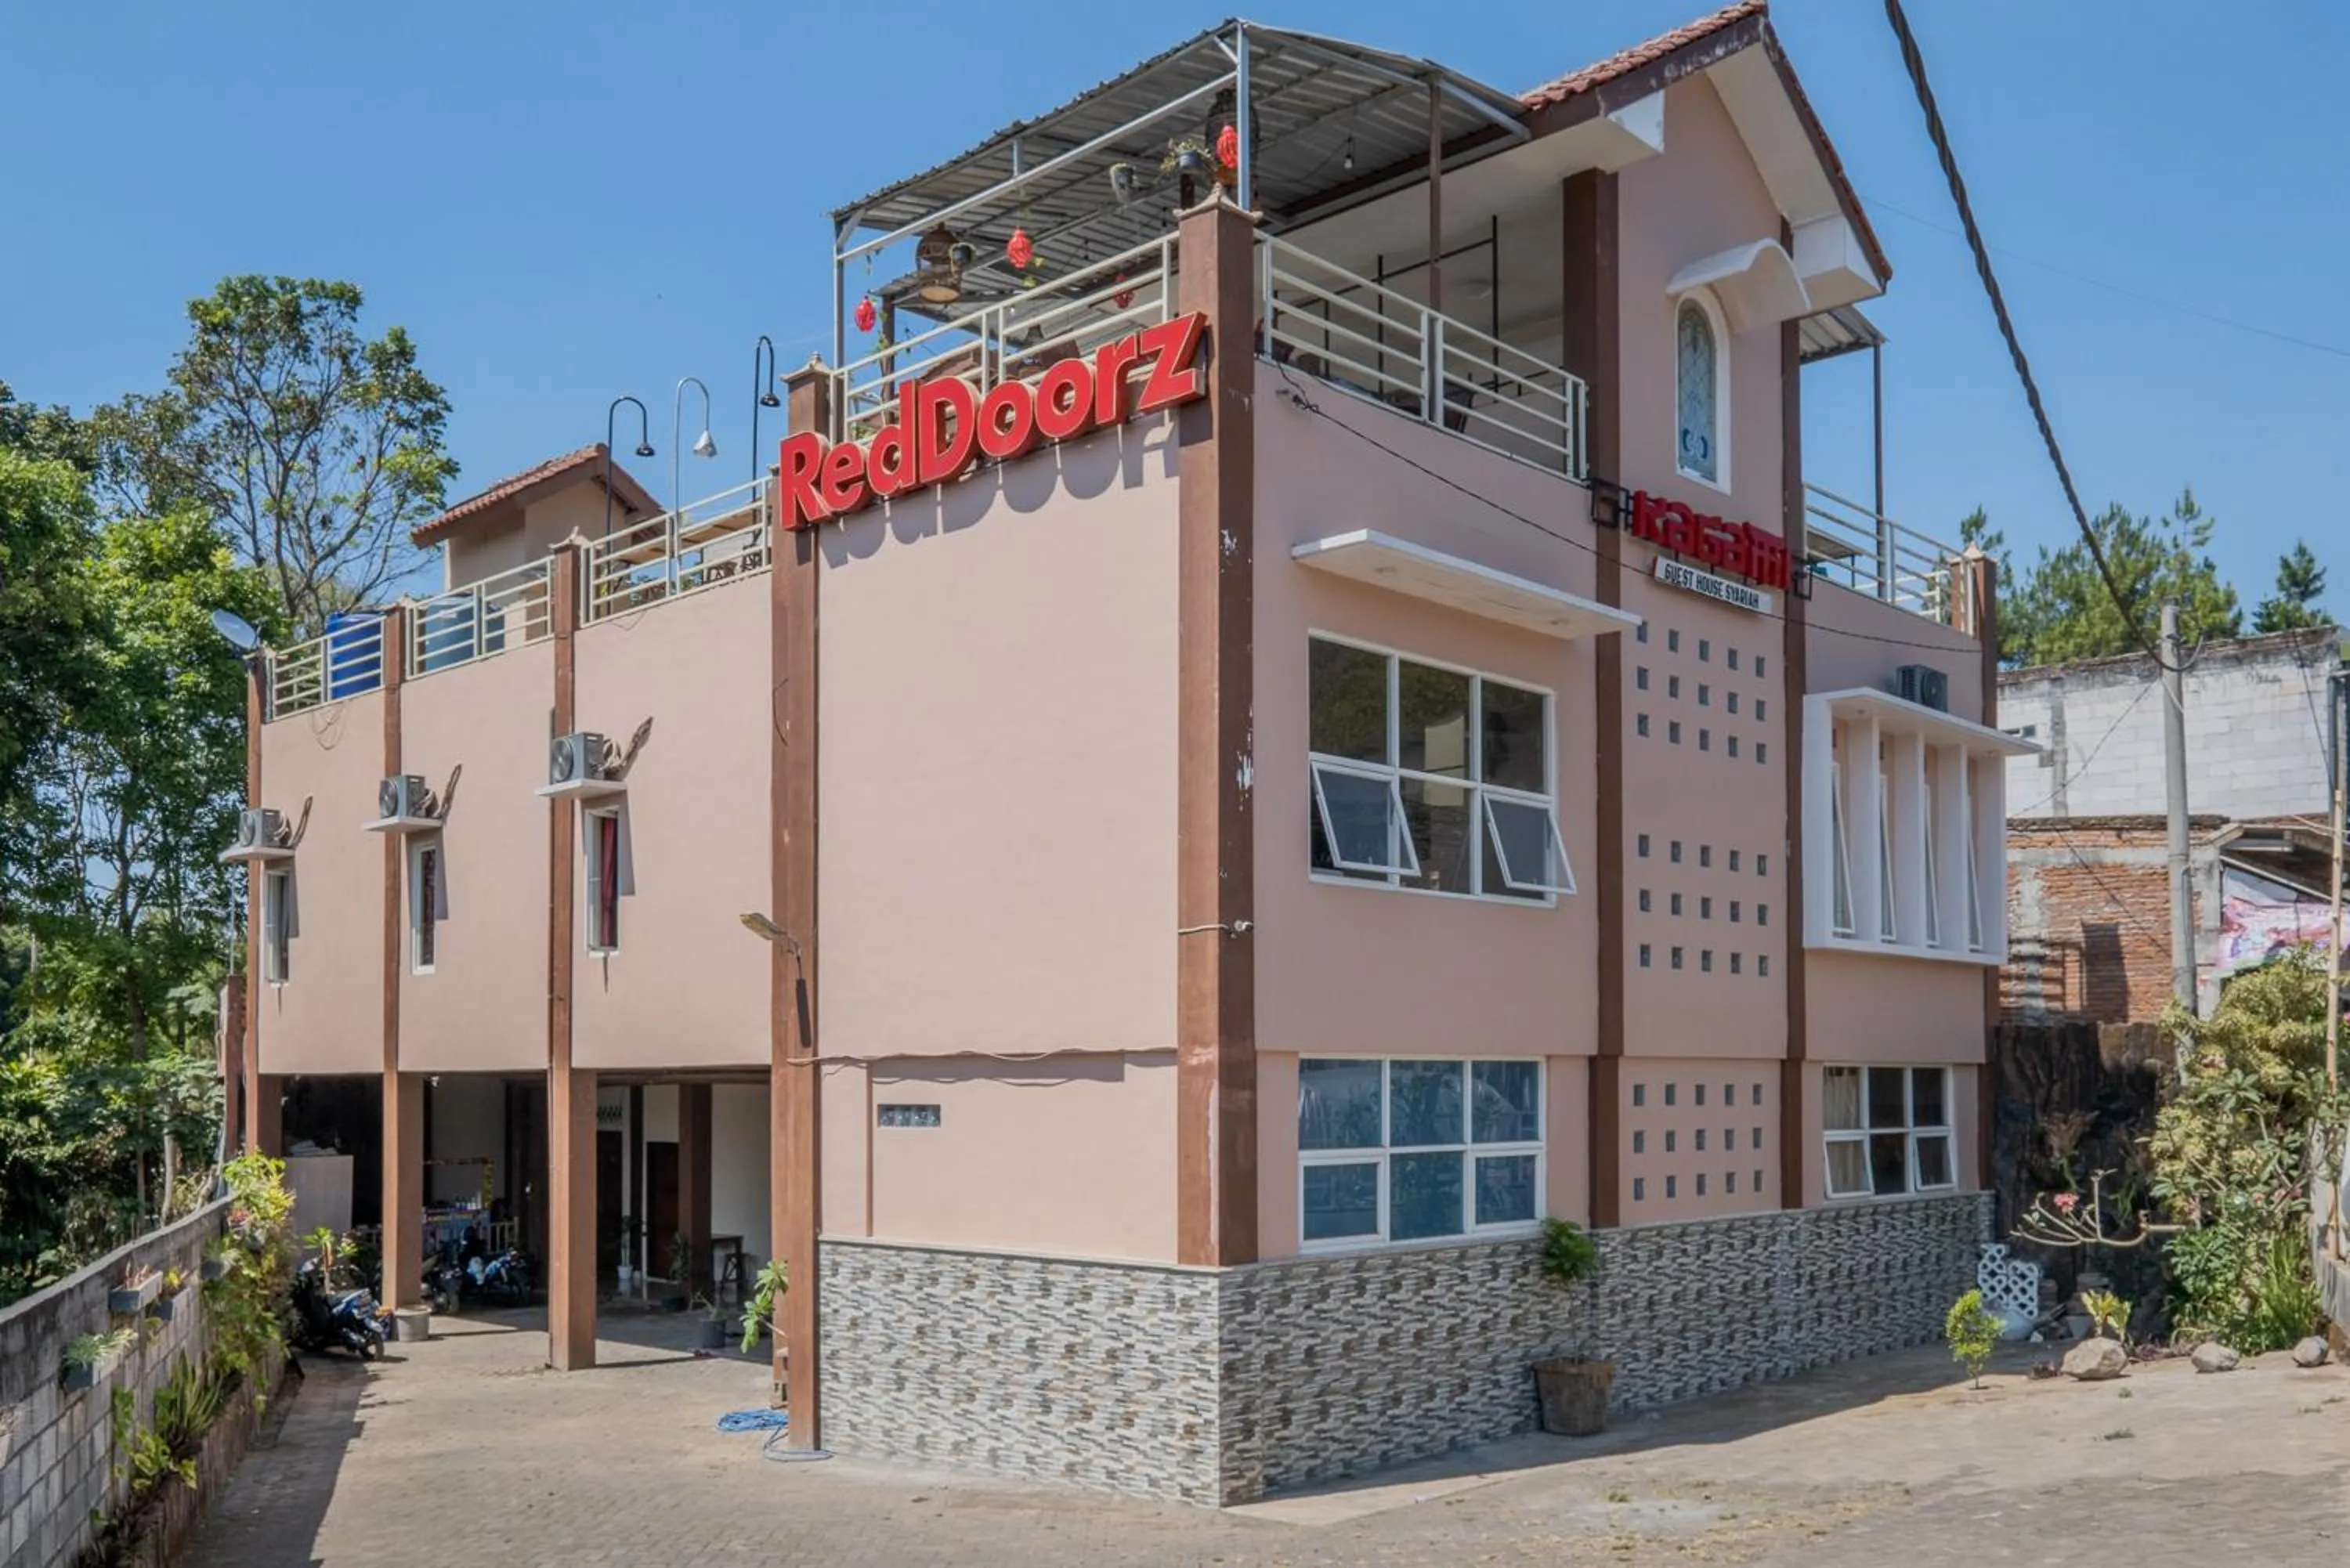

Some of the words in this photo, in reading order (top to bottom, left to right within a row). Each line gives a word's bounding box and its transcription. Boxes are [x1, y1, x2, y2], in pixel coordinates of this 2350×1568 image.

[780, 312, 1207, 531] RedDoorz
[1665, 563, 1694, 587] GUEST
[1696, 574, 1724, 598] HOUSE
[1726, 583, 1759, 609] SYARIAH
